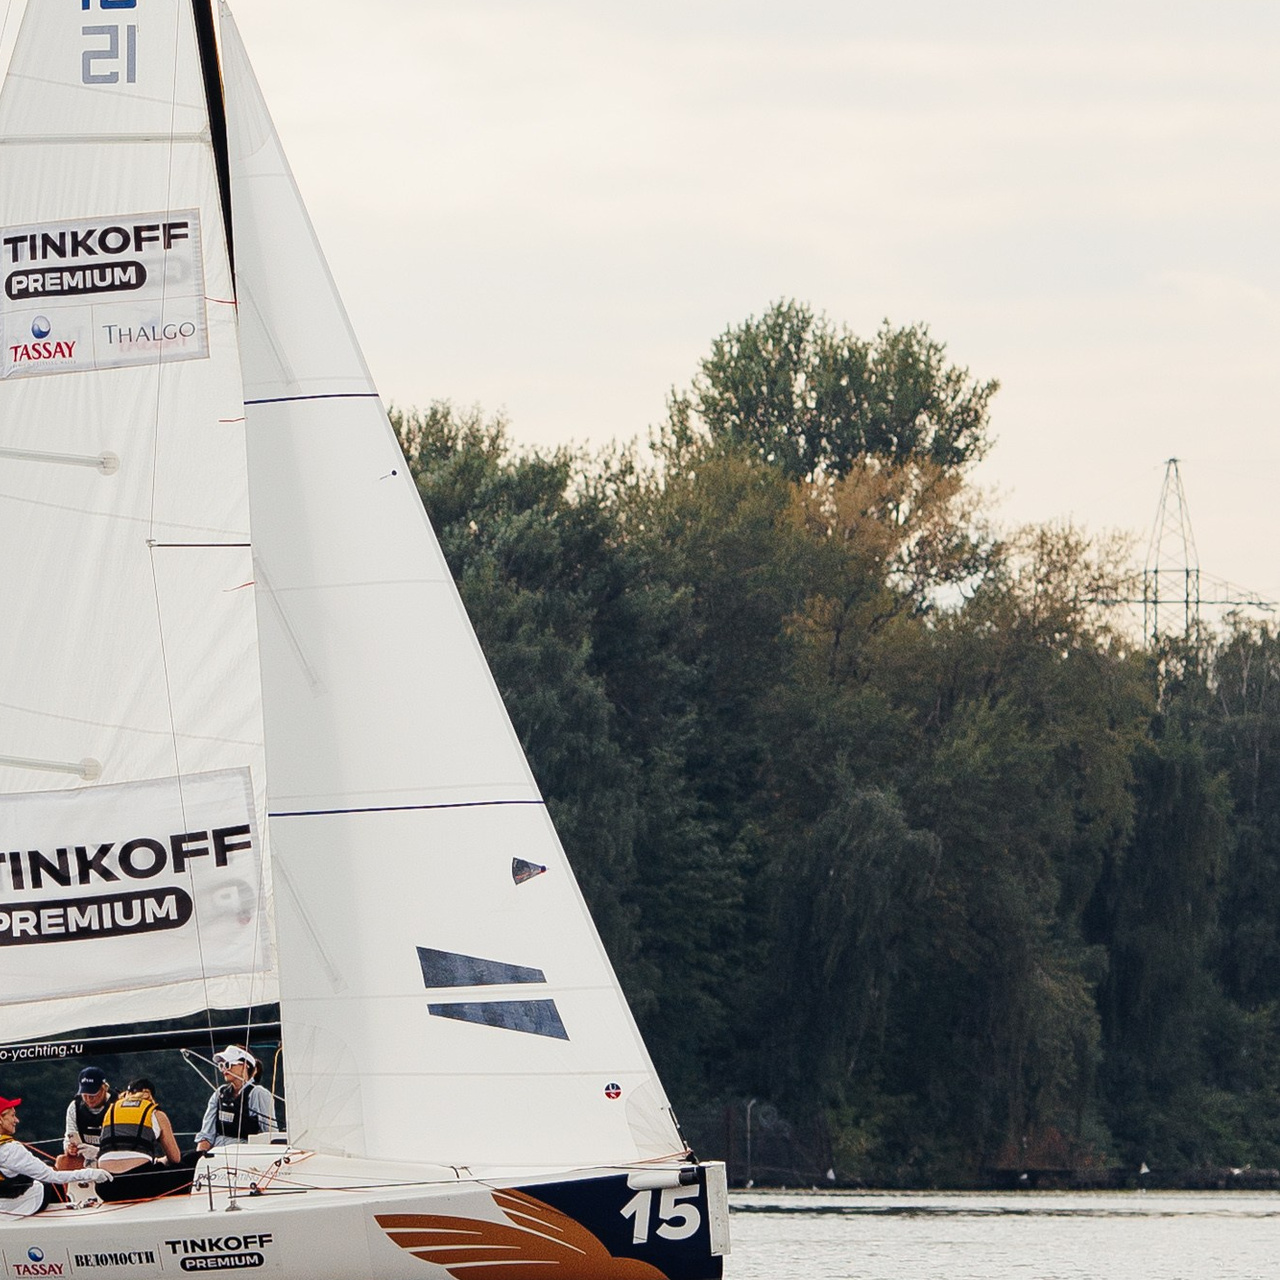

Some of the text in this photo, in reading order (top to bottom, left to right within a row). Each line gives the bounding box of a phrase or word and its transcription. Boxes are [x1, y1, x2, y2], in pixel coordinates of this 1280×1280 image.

[3, 222, 189, 263] TINKOFF
[11, 266, 137, 295] PREMIUM
[102, 322, 196, 345] THALGO
[10, 341, 76, 362] TASSAY
[620, 1184, 701, 1244] 15
[165, 1233, 273, 1254] TINKOFF
[13, 1263, 64, 1276] TASSAY
[74, 1251, 155, 1268] ВЕДОМОСТИ
[185, 1254, 259, 1270] PREMIUM
